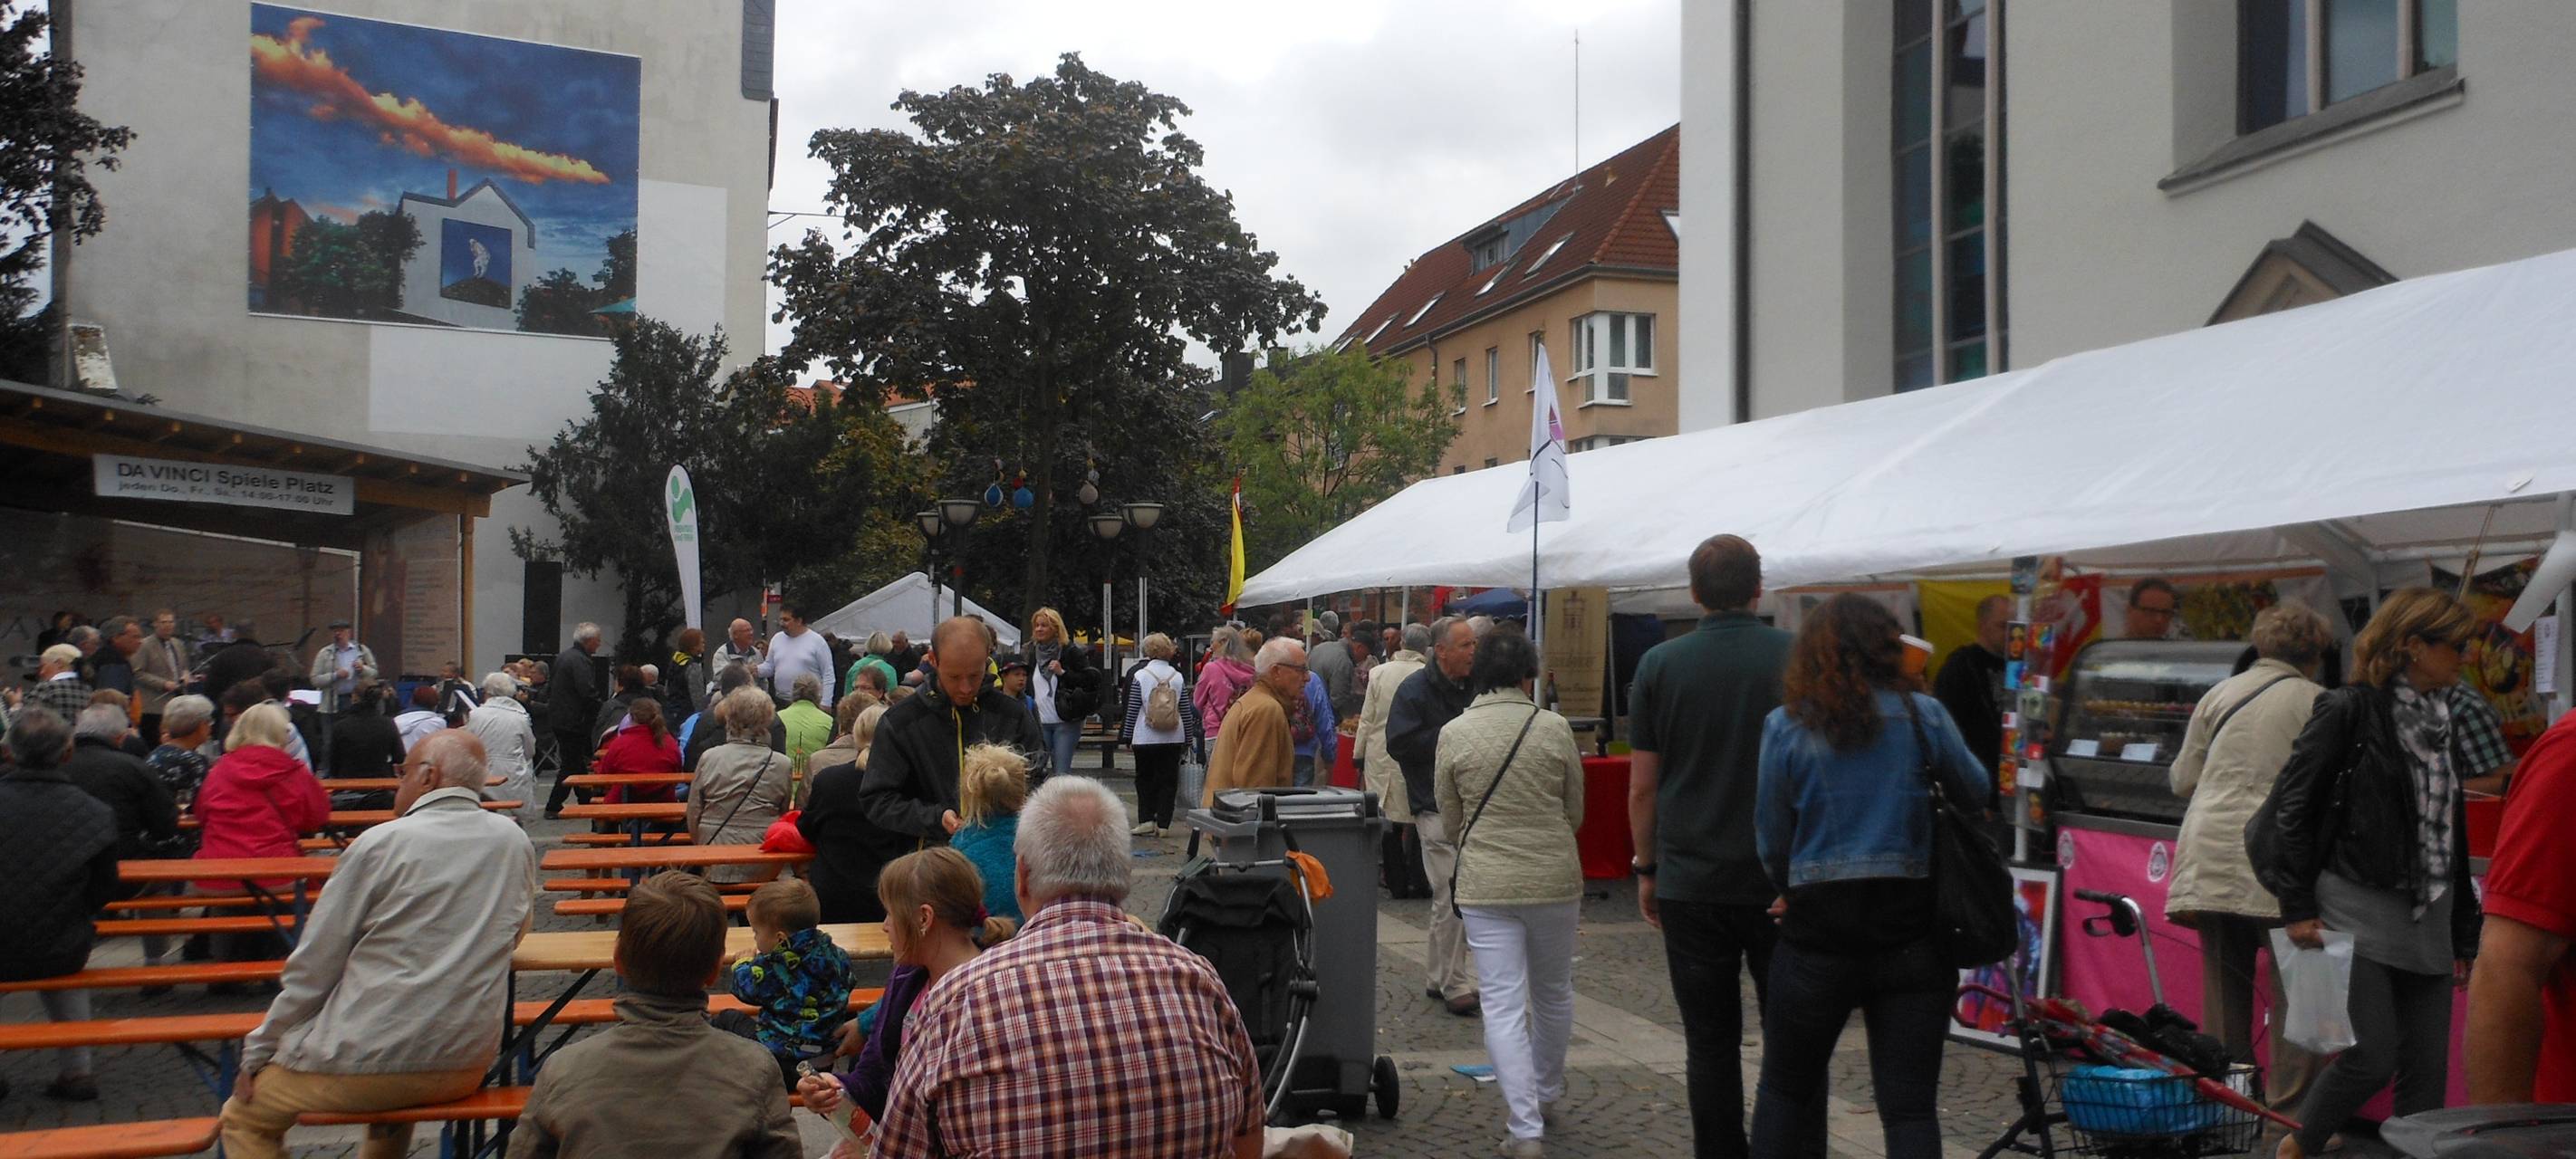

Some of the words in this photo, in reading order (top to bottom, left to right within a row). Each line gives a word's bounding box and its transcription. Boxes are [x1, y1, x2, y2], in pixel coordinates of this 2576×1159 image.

[118, 463, 145, 477] DA
[149, 465, 209, 483] VINCI
[217, 470, 280, 489] Spiele
[286, 477, 334, 494] Platz
[119, 481, 156, 492] jeden
[313, 496, 334, 506] Uhr
